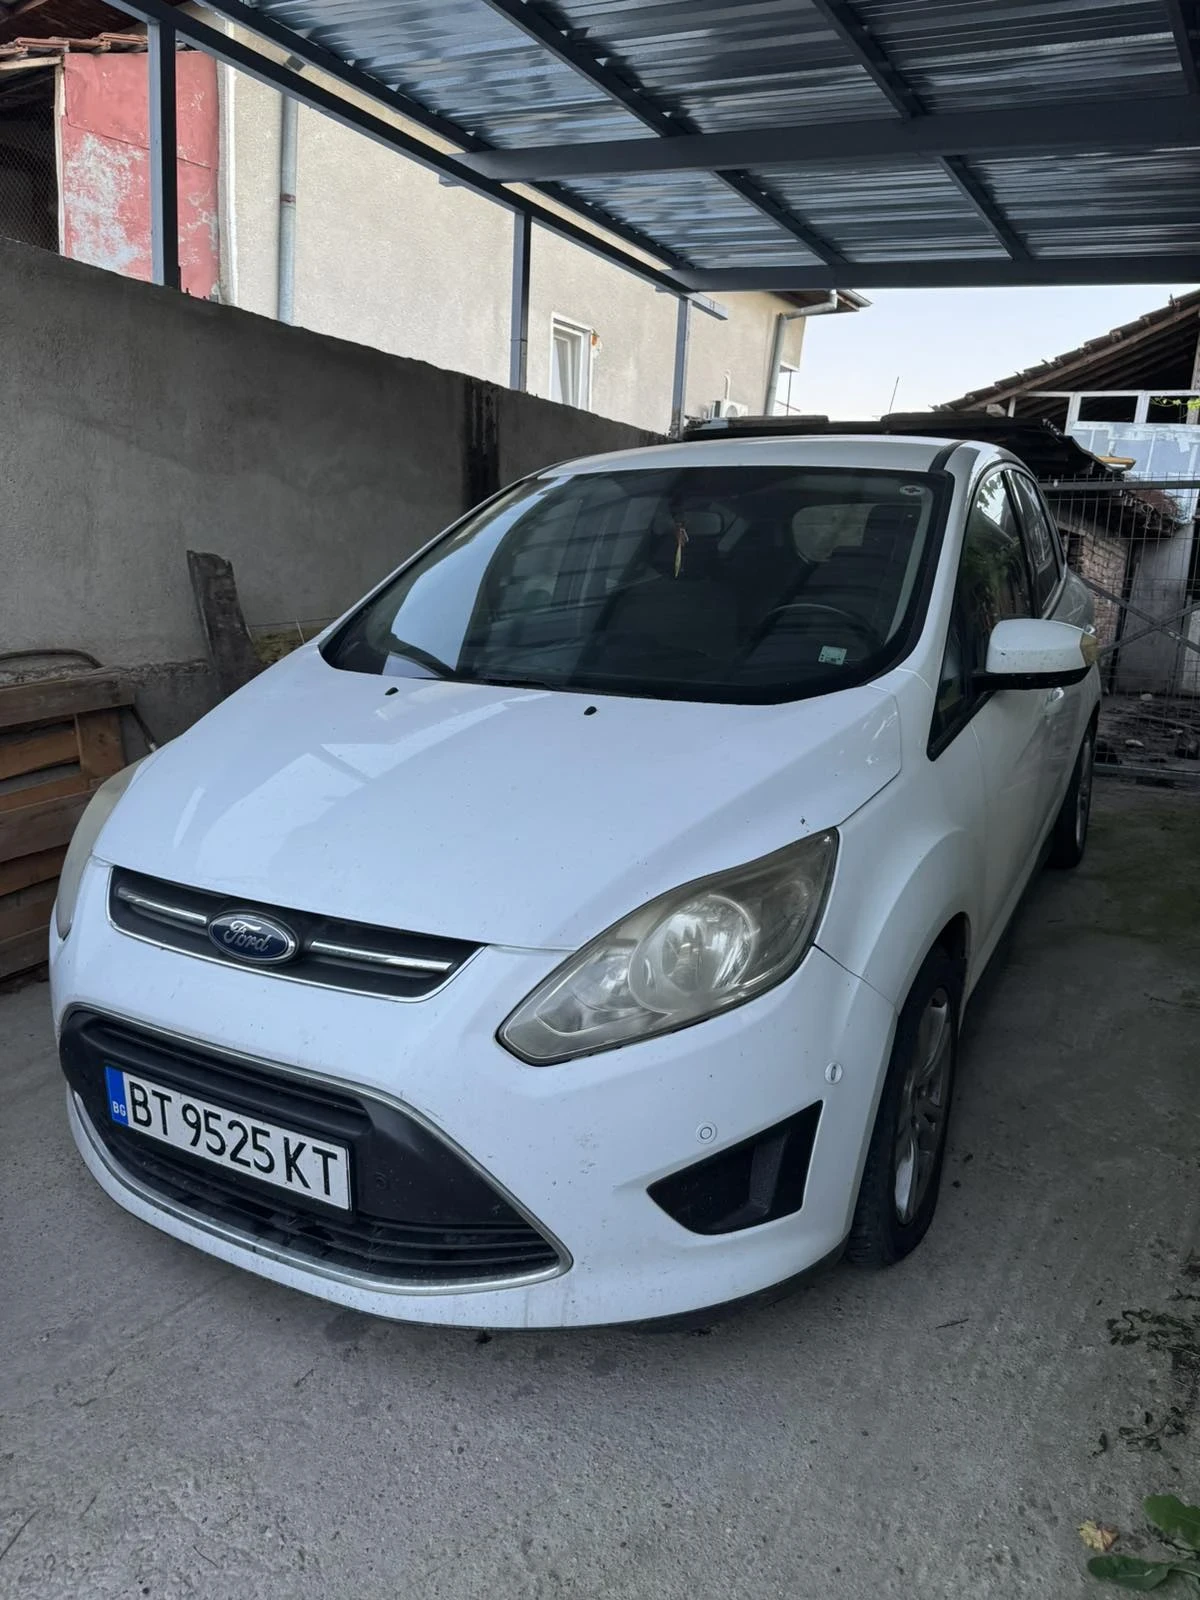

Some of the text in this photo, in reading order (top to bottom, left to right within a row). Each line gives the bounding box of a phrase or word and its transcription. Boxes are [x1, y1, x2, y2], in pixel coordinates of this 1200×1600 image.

[223, 920, 273, 952] Ford
[112, 1101, 127, 1117] BG
[129, 1080, 338, 1196] BT 9525 KT
